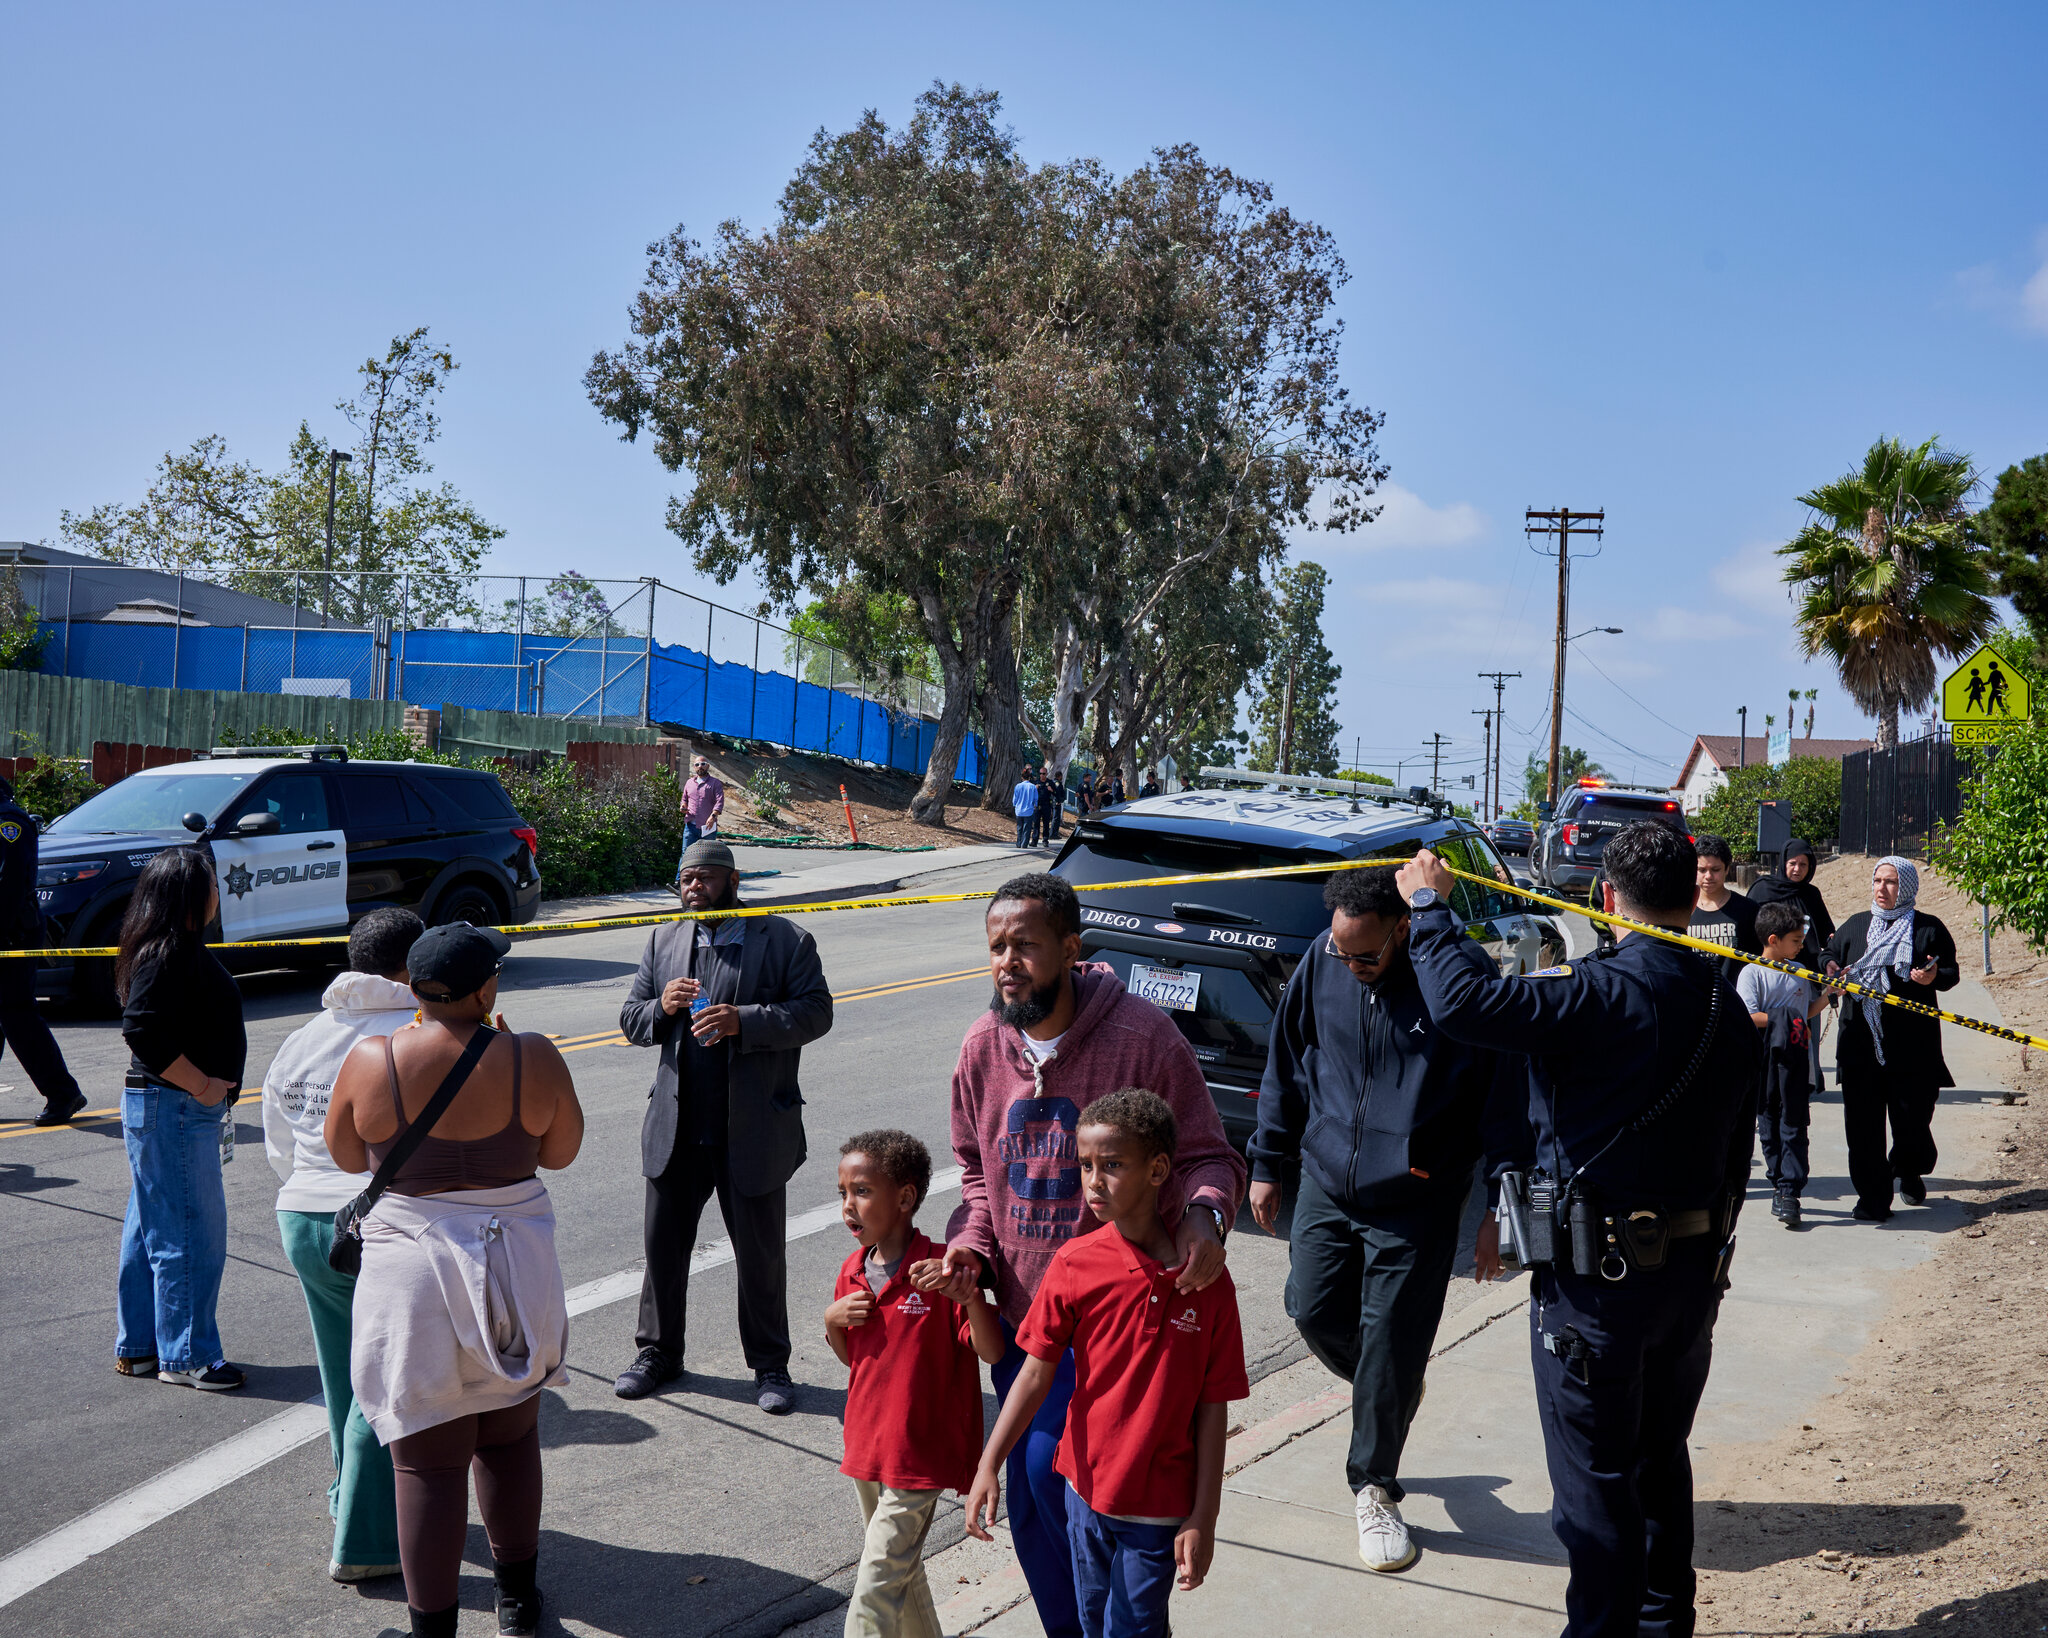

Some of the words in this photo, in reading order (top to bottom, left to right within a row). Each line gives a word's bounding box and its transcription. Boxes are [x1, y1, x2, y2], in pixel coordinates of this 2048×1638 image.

[255, 861, 341, 887] POLICE
[1085, 909, 1141, 930] DIEGO
[1207, 929, 1277, 950] POLICE
[1159, 973, 1184, 982] EXEMPT
[1135, 979, 1194, 1004] 1667222
[284, 1080, 304, 1088] Dear
[284, 1092, 299, 1100] the
[320, 1095, 329, 1104] is
[317, 1107, 326, 1116] in
[998, 1131, 1078, 1162] CHAMPIO
